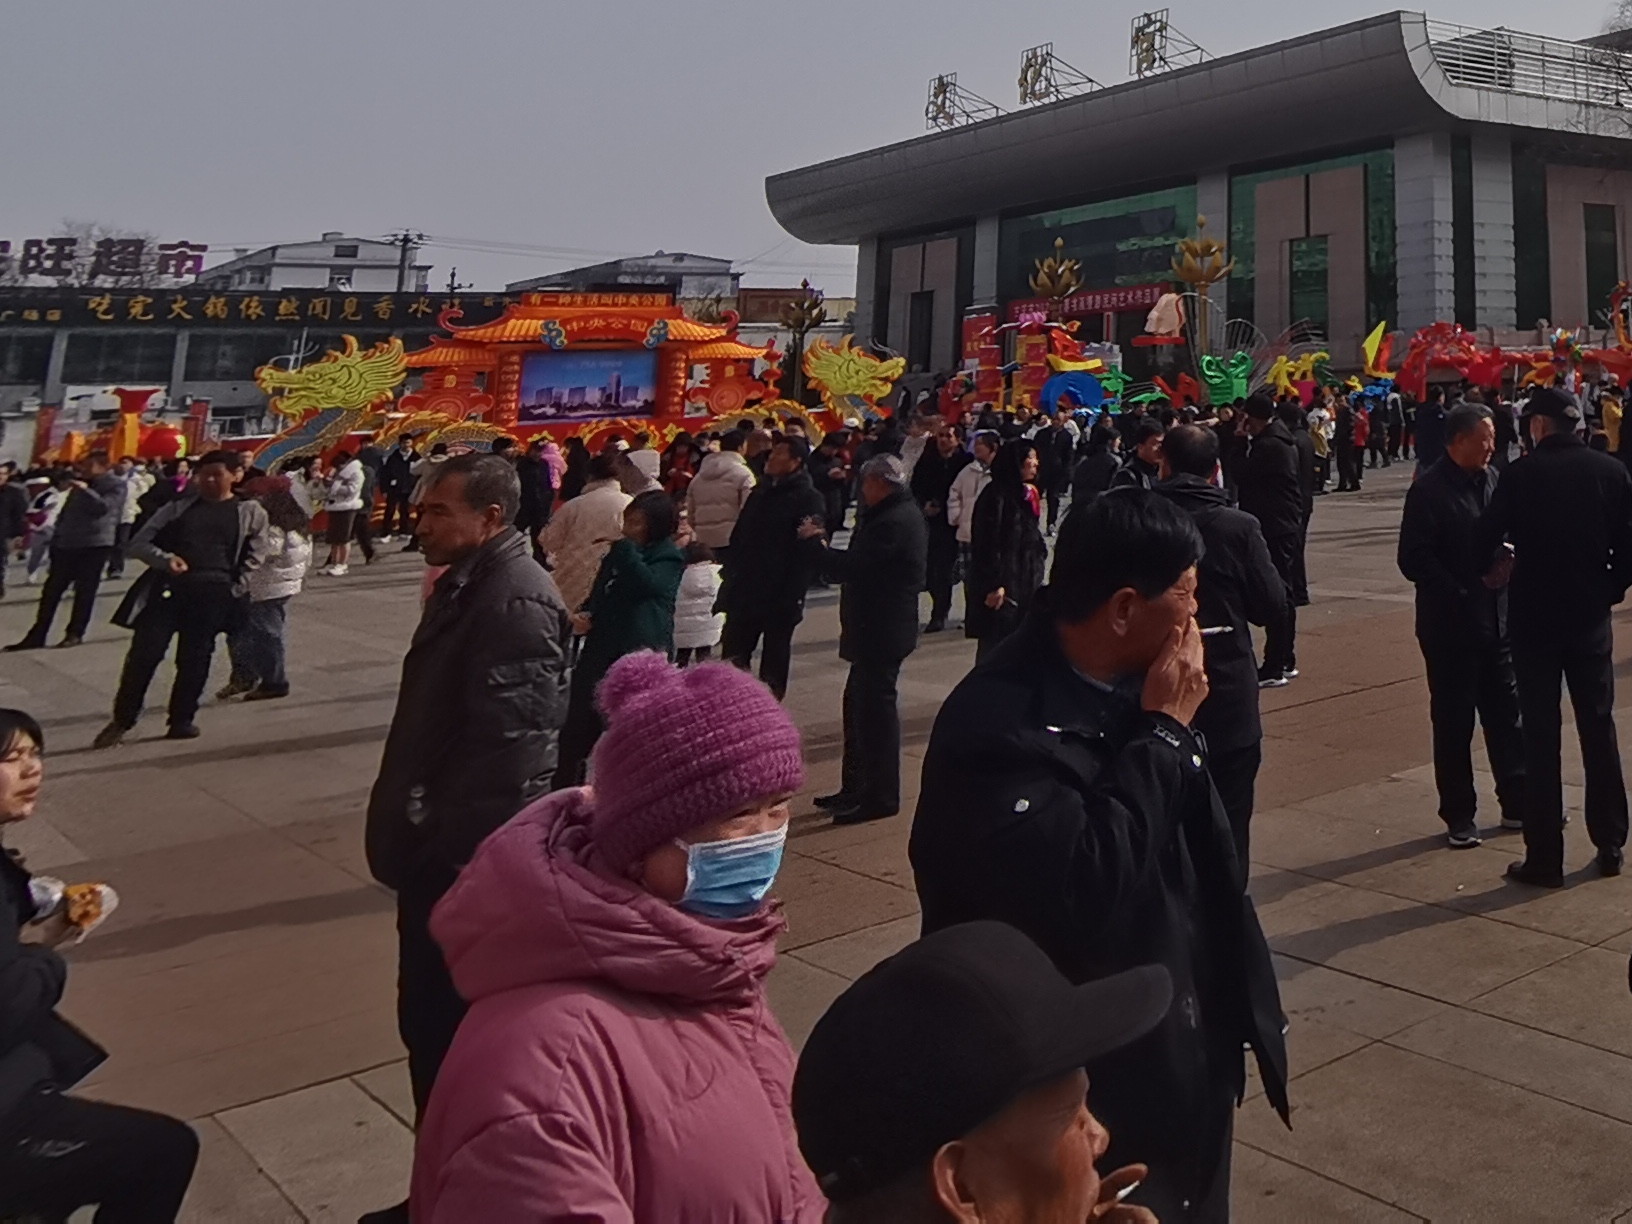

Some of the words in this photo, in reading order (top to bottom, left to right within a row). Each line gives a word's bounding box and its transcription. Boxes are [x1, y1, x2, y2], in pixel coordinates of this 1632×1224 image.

[0, 237, 208, 278] 旺超市
[530, 293, 667, 306] 有一种生活叫中央公园
[566, 316, 648, 333] 中央公园
